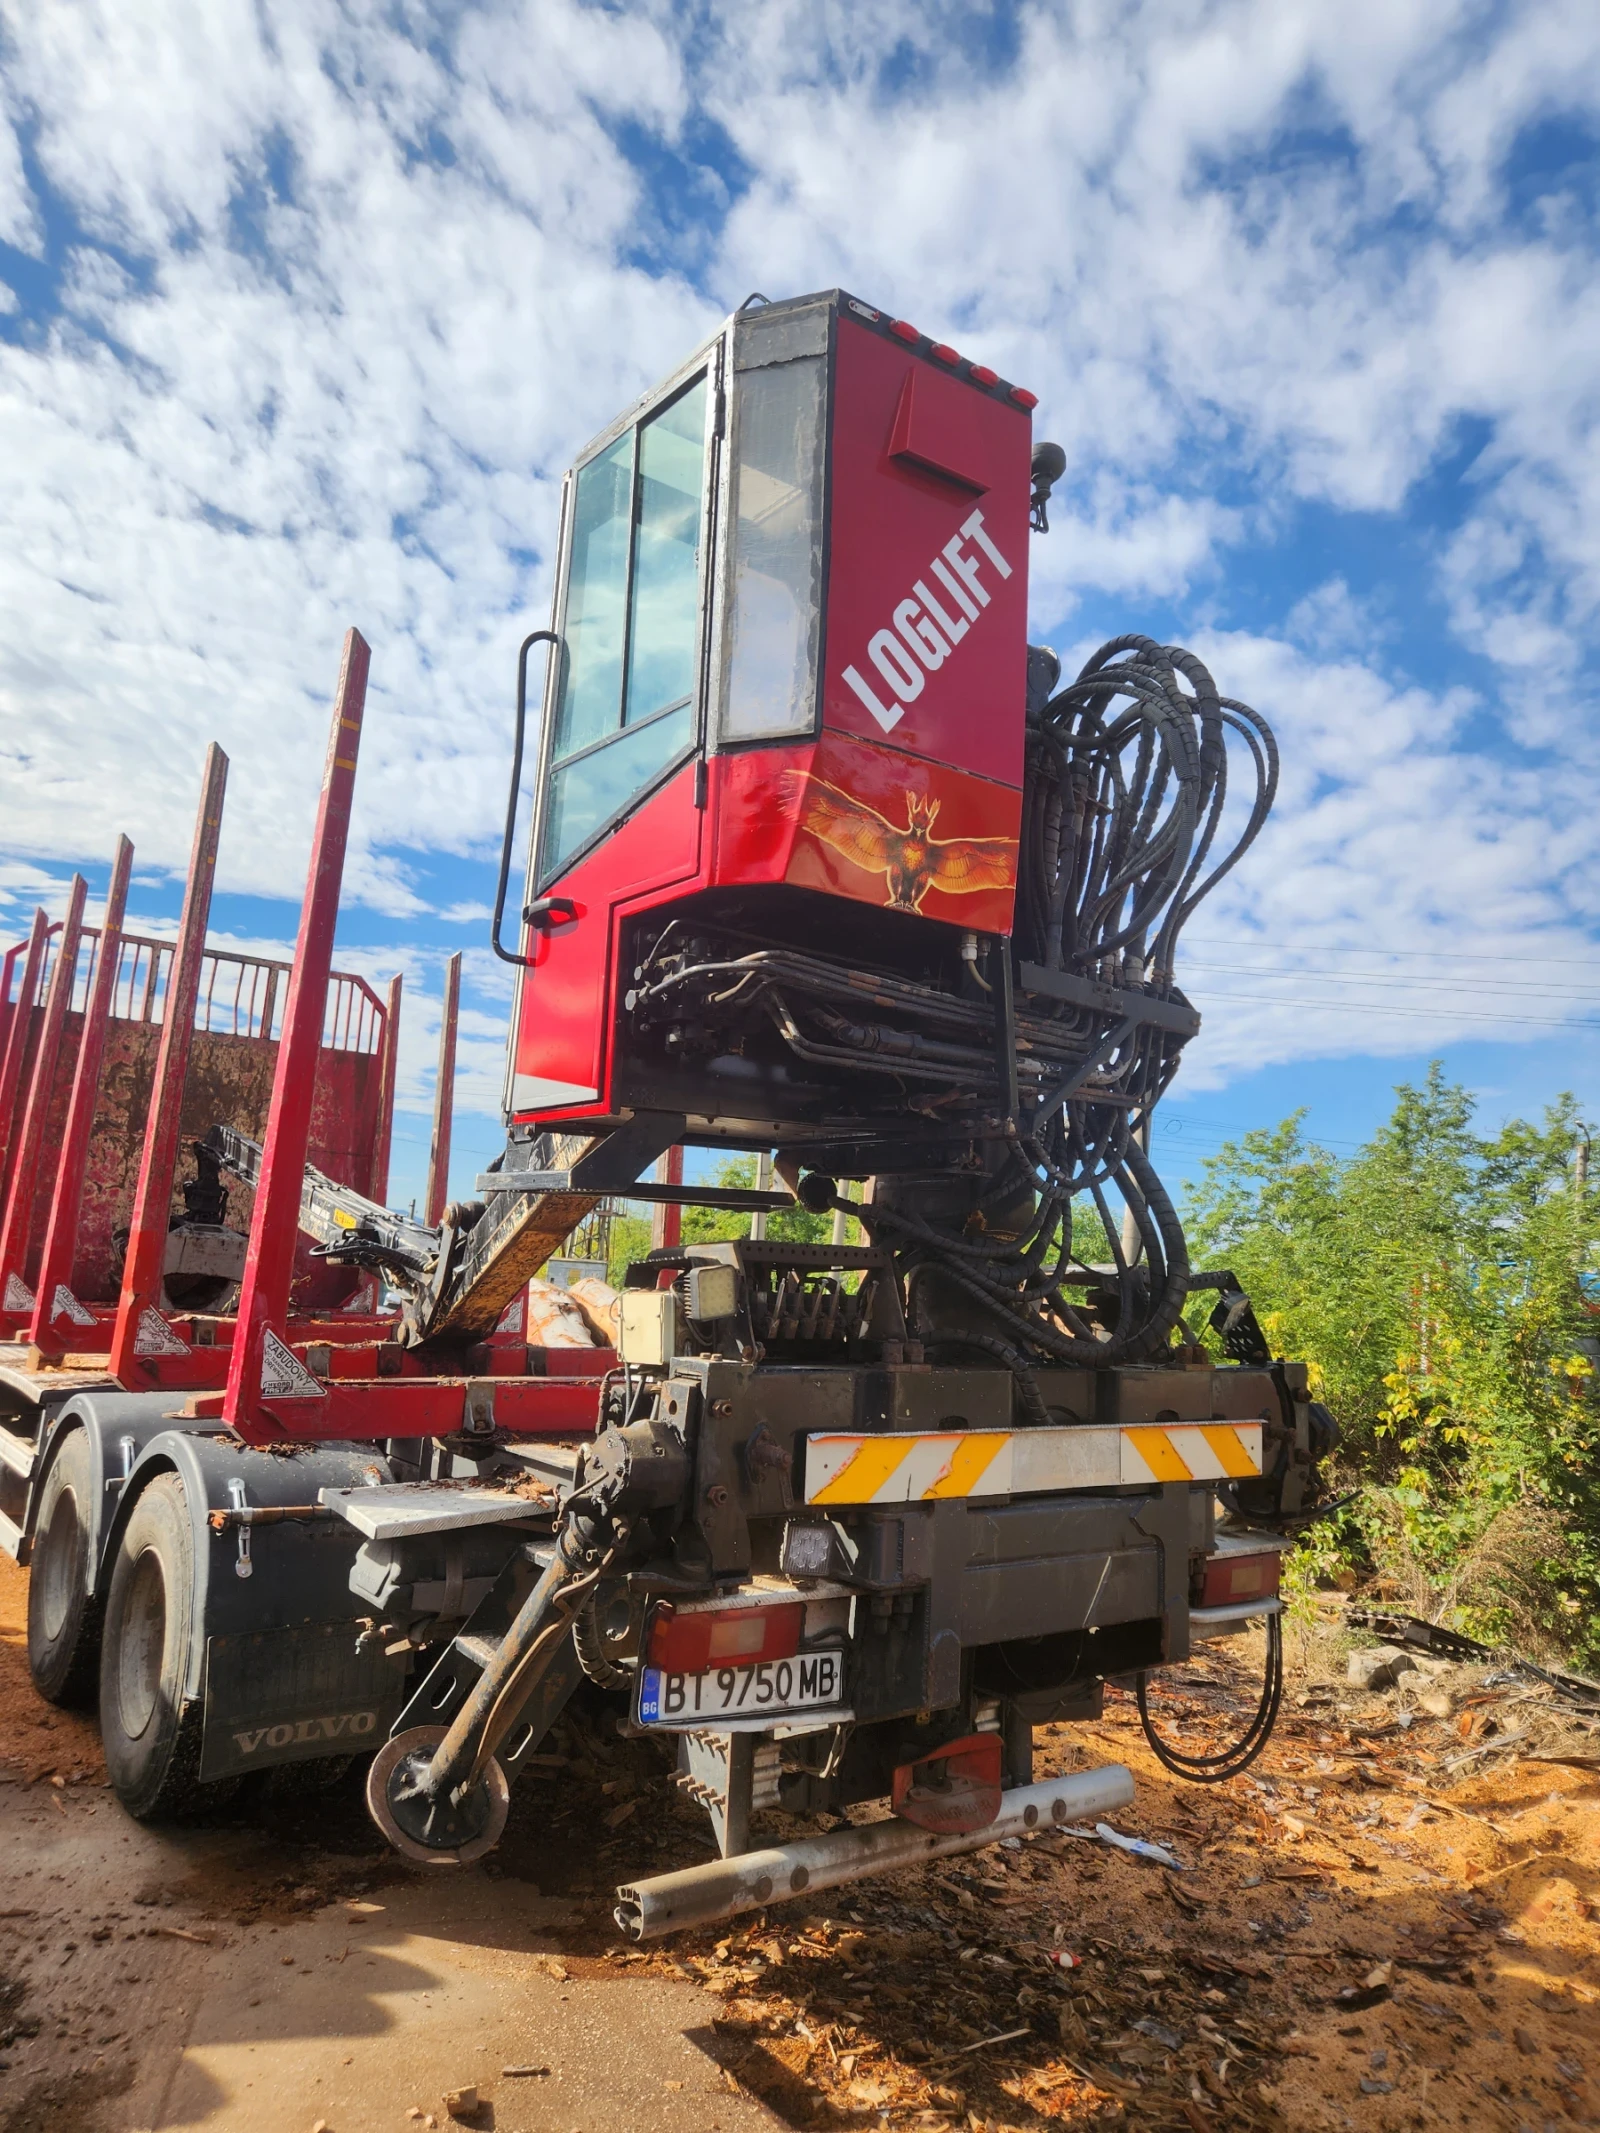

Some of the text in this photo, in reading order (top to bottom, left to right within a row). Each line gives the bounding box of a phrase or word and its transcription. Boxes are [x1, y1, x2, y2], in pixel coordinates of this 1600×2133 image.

[841, 508, 1013, 734] LOGLIFT
[264, 1358, 284, 1380] DREWNA
[267, 1341, 312, 1386] ZABUDOWY
[642, 1701, 657, 1714] BG
[664, 1657, 835, 1714] BT 9750 MB
[232, 1711, 377, 1755] VOLVO
